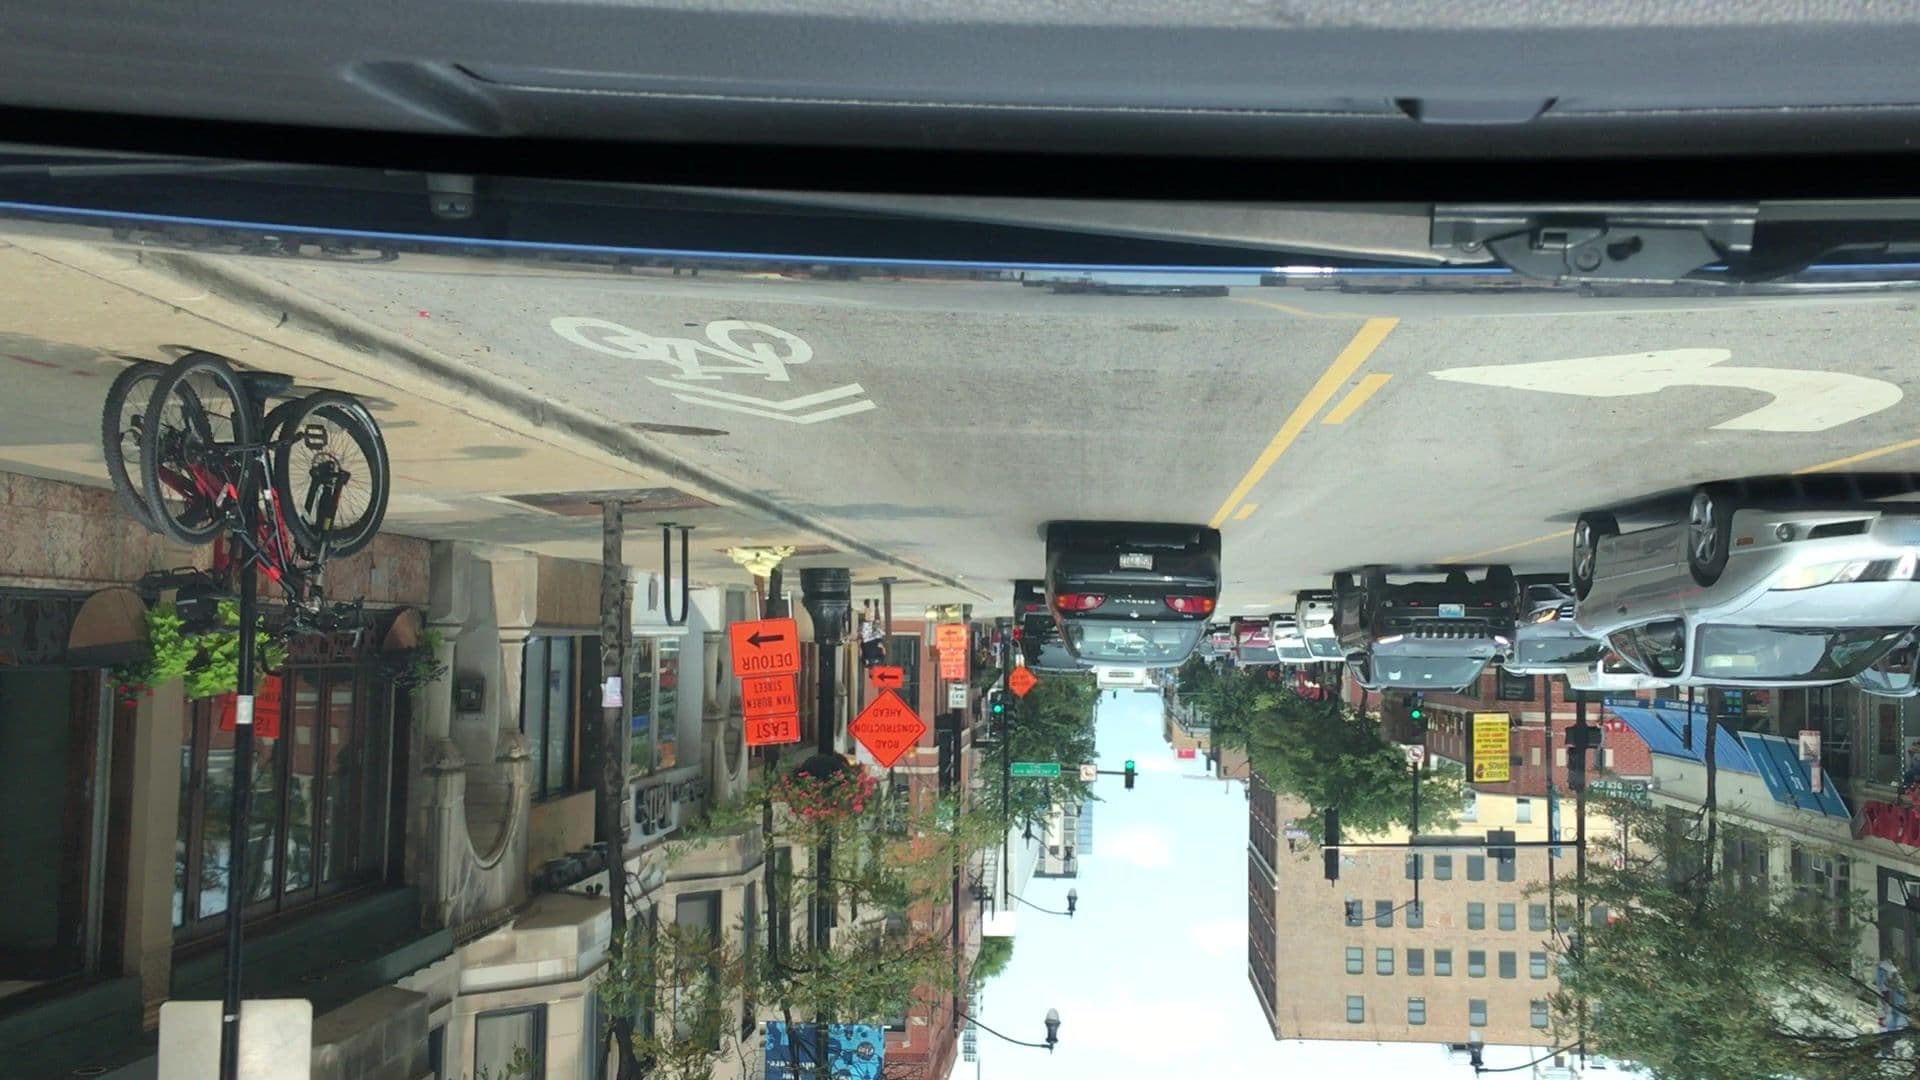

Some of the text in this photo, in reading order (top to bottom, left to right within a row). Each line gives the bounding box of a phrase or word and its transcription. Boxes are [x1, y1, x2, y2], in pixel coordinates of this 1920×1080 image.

[742, 653, 793, 671] DETOUR
[754, 680, 782, 694] STREET
[746, 695, 791, 709] VAN BUREN
[872, 708, 901, 718] AHEAD
[756, 721, 789, 738] EAST
[854, 723, 920, 734] CONSTRUCTION
[874, 740, 900, 749] ROAD
